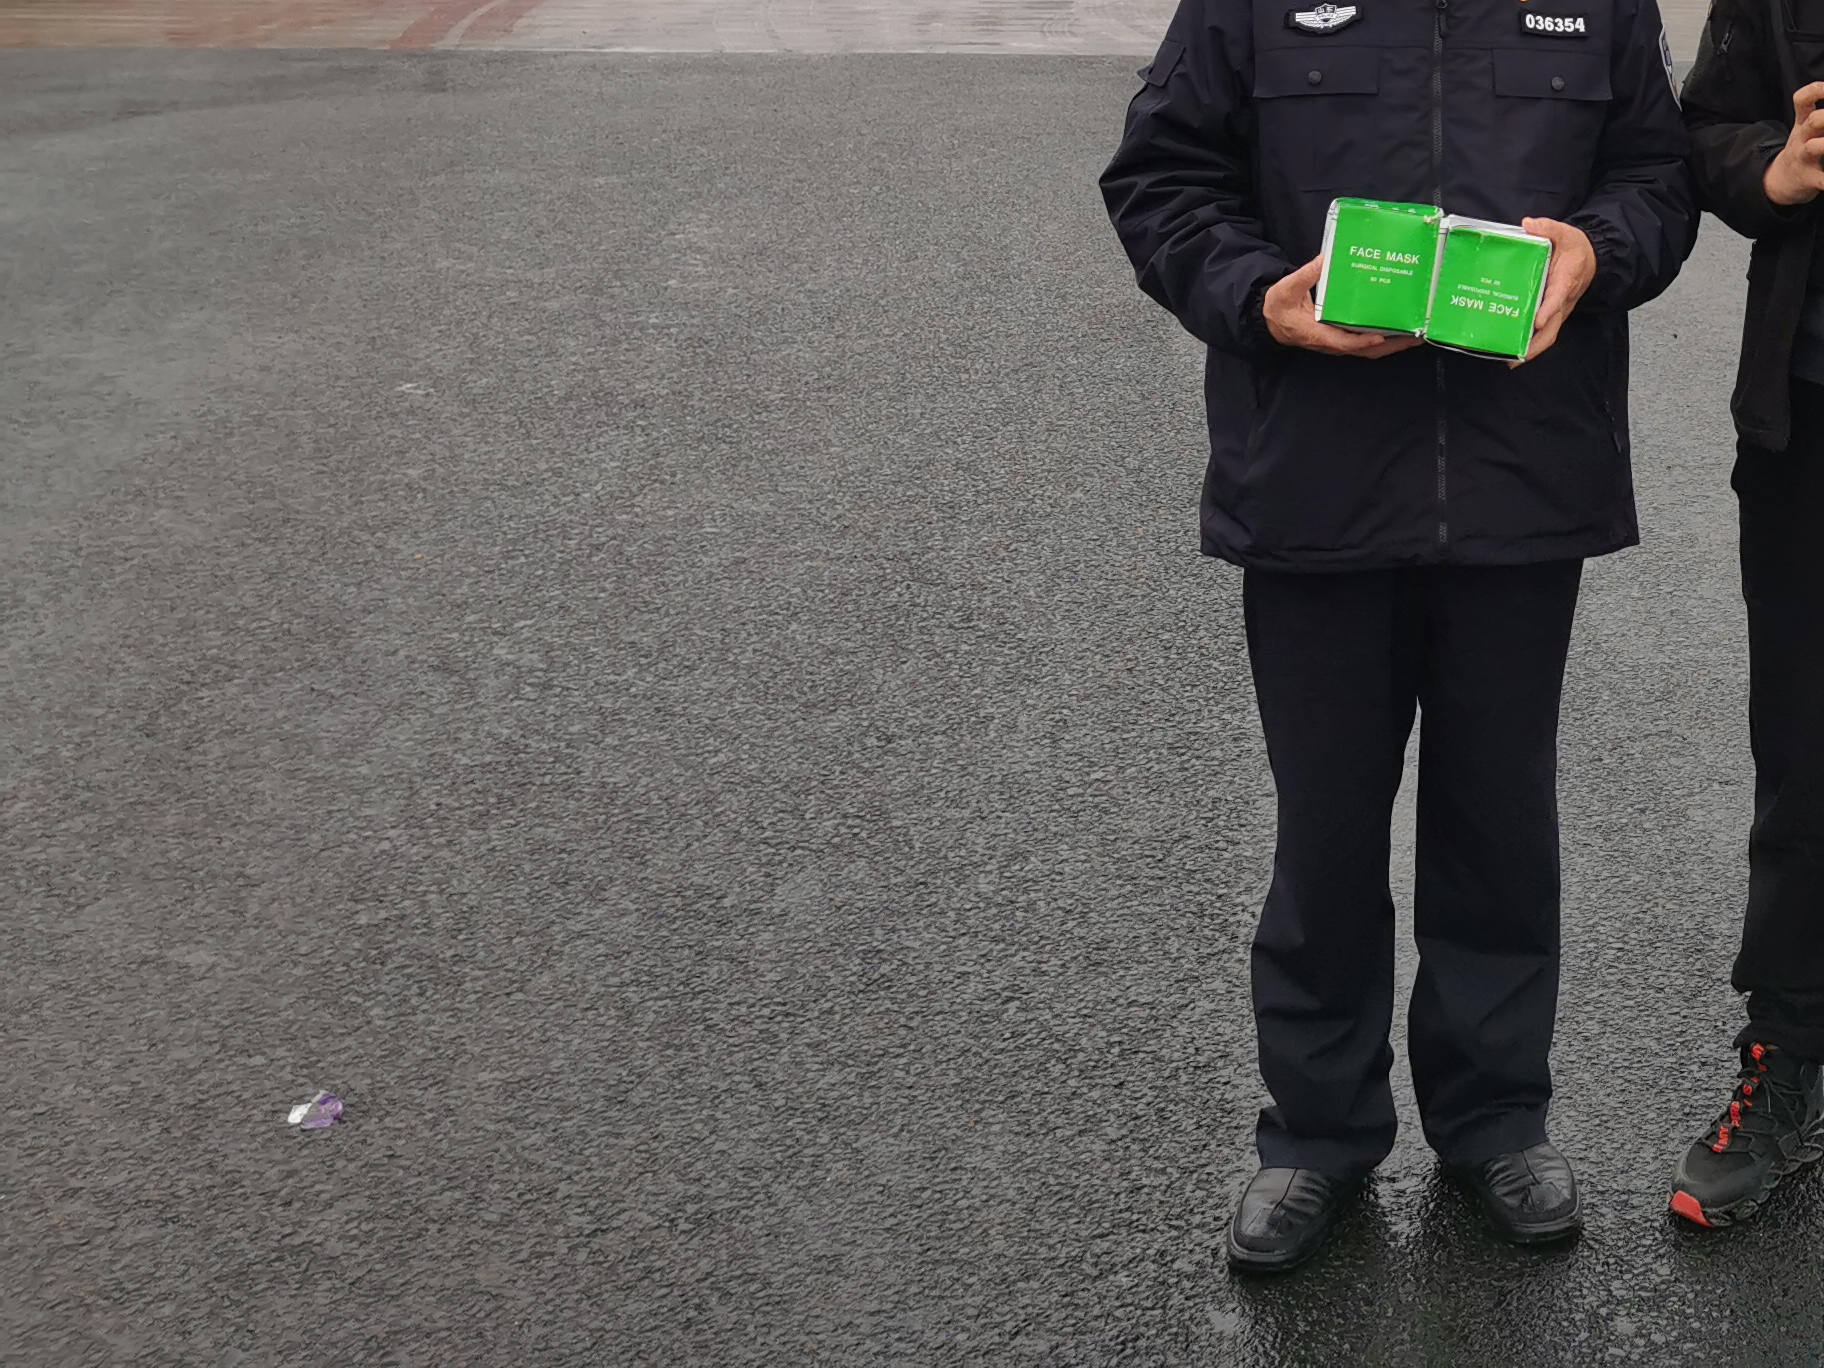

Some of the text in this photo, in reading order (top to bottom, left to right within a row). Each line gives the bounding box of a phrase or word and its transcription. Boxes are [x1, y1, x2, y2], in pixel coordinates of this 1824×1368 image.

[1525, 13, 1586, 33] 036354
[1349, 246, 1420, 265] FACE MASK
[1350, 262, 1378, 271] SURGICAL
[1450, 295, 1519, 317] FACE MASK
